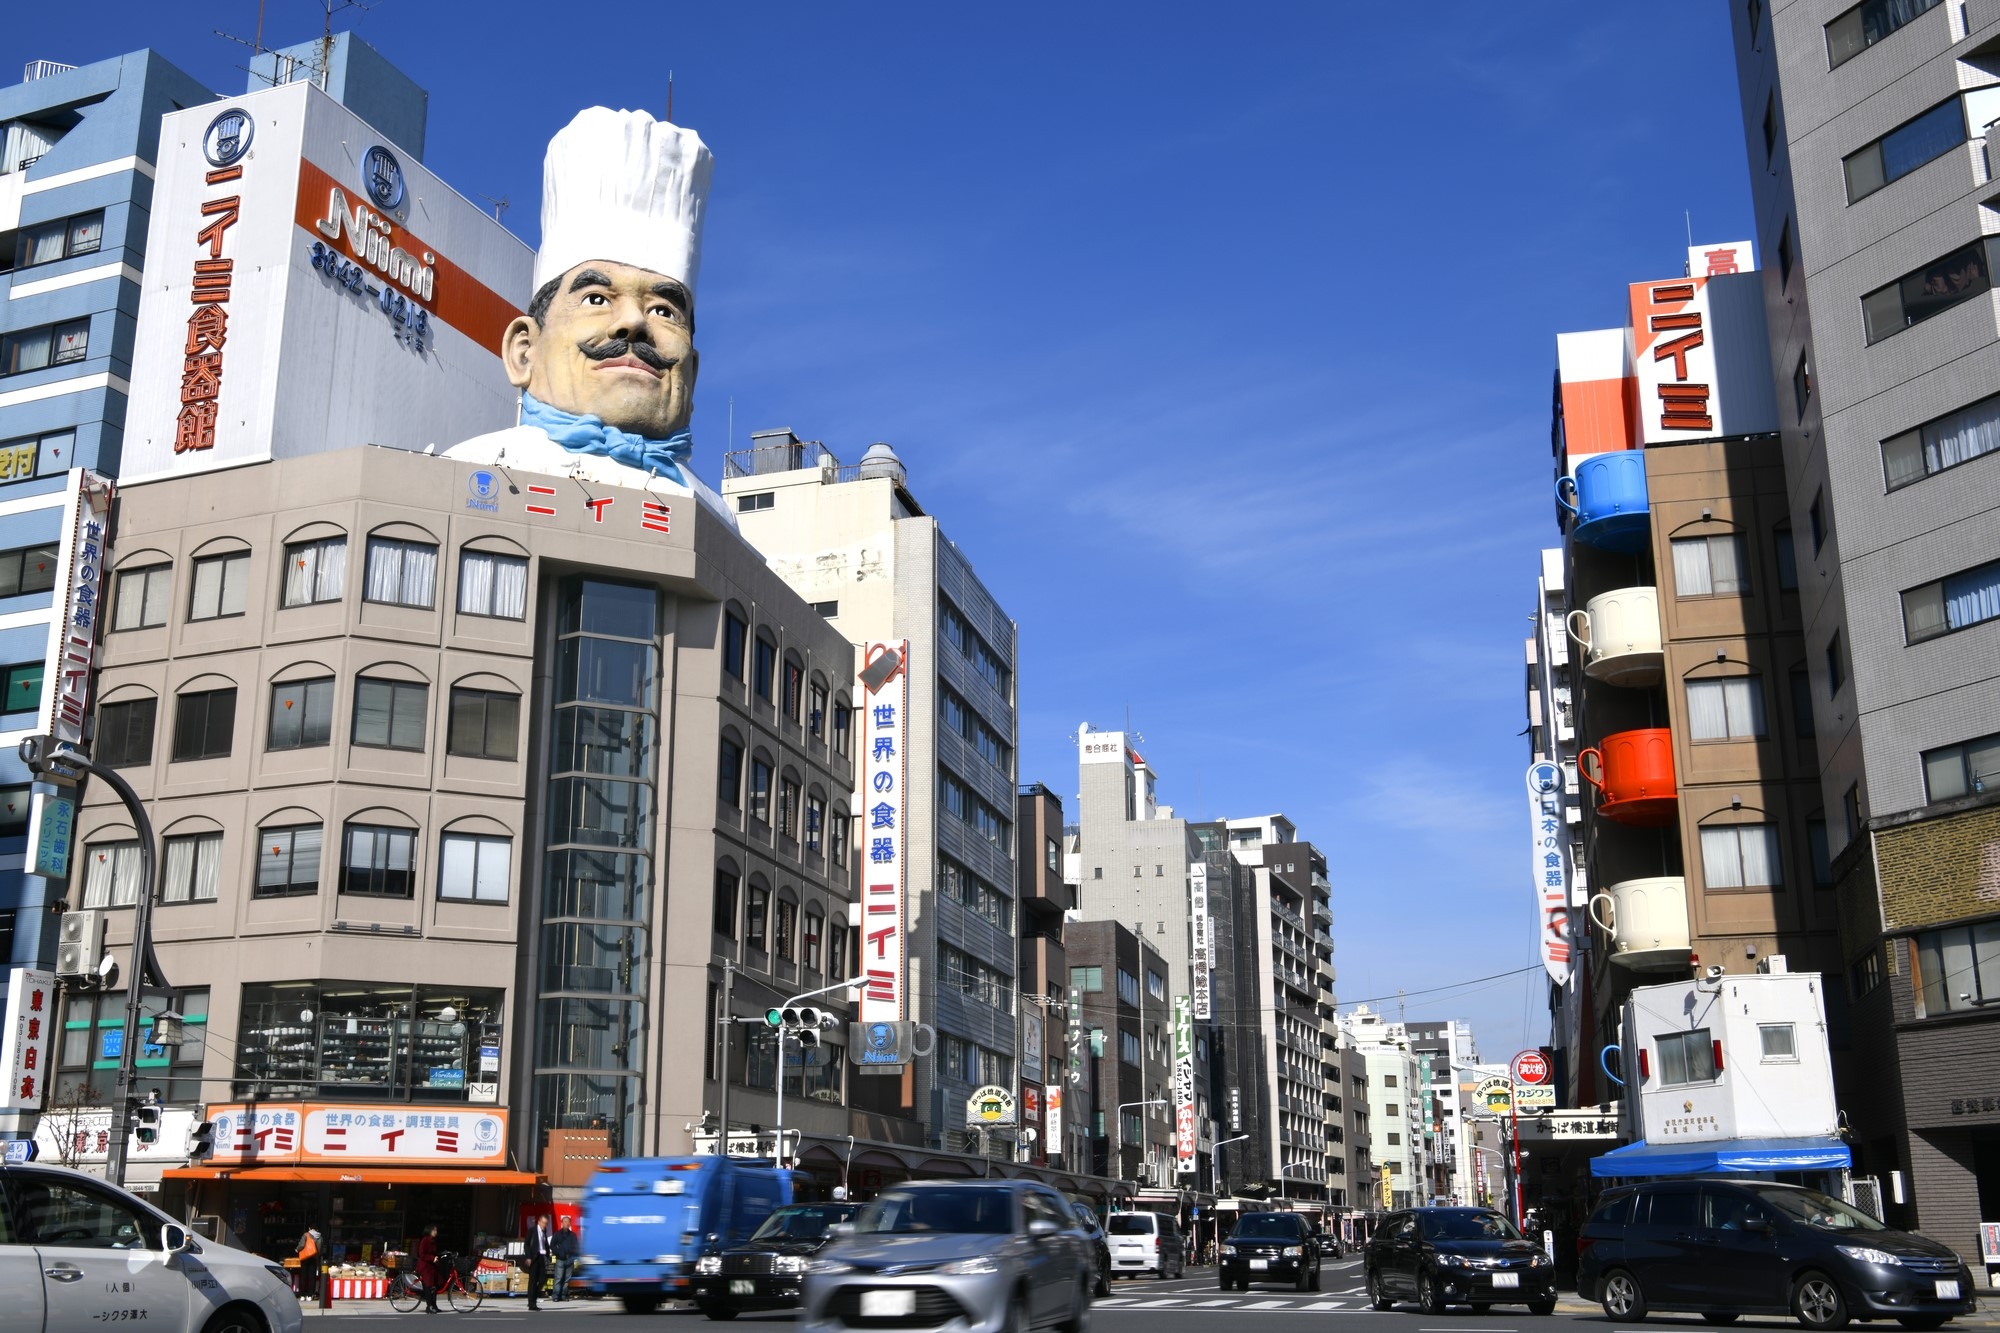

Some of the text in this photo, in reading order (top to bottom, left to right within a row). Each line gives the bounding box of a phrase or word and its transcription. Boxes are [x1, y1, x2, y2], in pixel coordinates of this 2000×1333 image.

[316, 187, 434, 302] Niimi
[311, 241, 428, 336] 3842-0213
[175, 165, 244, 454] ニイミ食器館
[1651, 284, 1712, 430] ニイミ
[466, 499, 499, 512] Niimi
[526, 484, 671, 534] ニイミ
[60, 520, 101, 728] 世界の食器 ニイミ
[40, 817, 53, 869] クリニック
[867, 704, 897, 1003] 世界の食器 ニイミ
[1541, 801, 1571, 963] 日本の食器 ニイミ
[26, 977, 52, 986] TOHAKU
[21, 988, 44, 1100] 東京白衣
[860, 1049, 898, 1064] Niimi
[1183, 1058, 1192, 1102] イシヤマ
[1520, 1063, 1544, 1075] 消火栓
[430, 1079, 461, 1087] Noritake
[471, 1084, 495, 1095] N4
[1176, 1062, 1184, 1105] 3842-1480
[1476, 1079, 1513, 1098] かっぱ橋道
[1516, 1089, 1554, 1098] カジワラ
[236, 1113, 296, 1126] 世界の食器
[325, 1113, 460, 1130] 世界の食器・調理器具
[1179, 1109, 1193, 1153] かんばん
[1536, 1120, 1619, 1134] かっぱ橋道具街
[233, 1127, 294, 1151] ニイミ
[323, 1128, 459, 1153] ニイミ
[472, 1141, 497, 1152] Niimi
[708, 1141, 776, 1154] かぱ橋道具街
